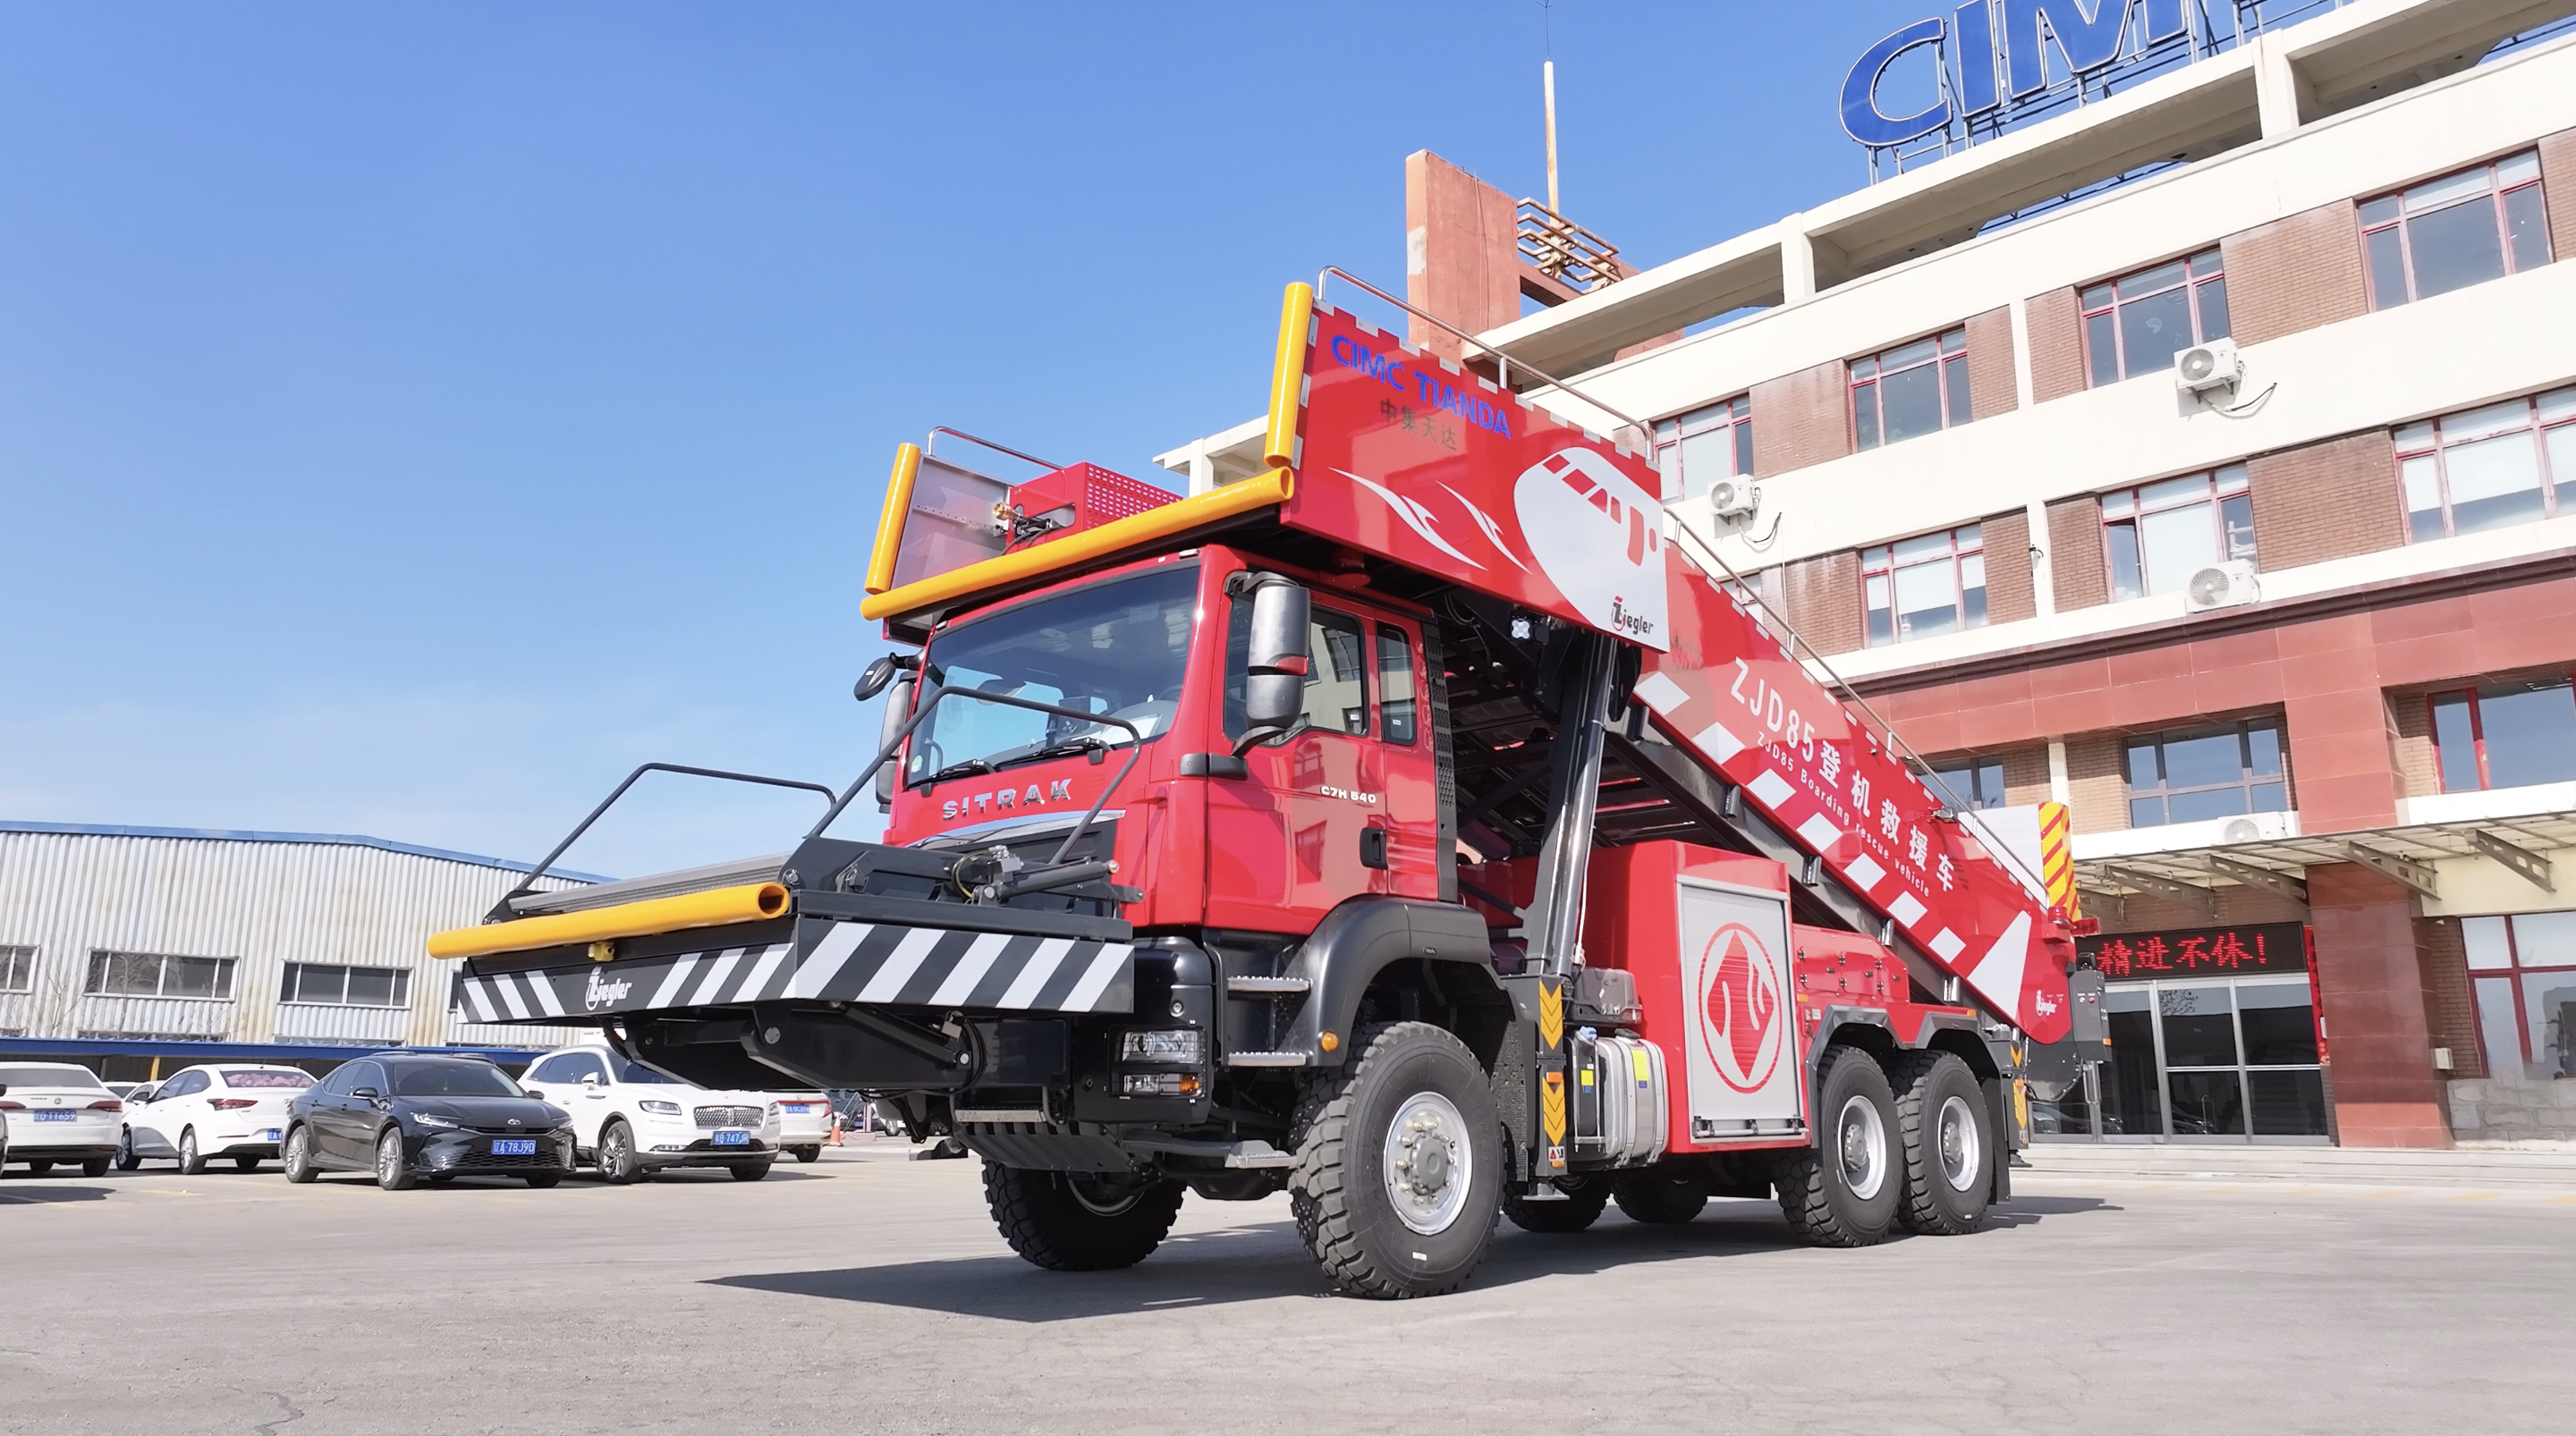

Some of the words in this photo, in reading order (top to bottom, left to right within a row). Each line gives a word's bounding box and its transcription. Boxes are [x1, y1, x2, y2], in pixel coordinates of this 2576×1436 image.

[1331, 334, 1405, 392] CIMC
[1413, 370, 1512, 439] TIANDA
[1380, 398, 1456, 451] 中集天达
[1611, 596, 1654, 635] Ziegler
[1321, 785, 1347, 799] C7H
[1350, 790, 1377, 804] 540
[1731, 656, 1954, 892] ZJD85登机救援车
[943, 778, 1073, 821] SITRAK
[1757, 731, 1793, 772] ZJD85
[1801, 768, 1850, 826] Boarding
[1855, 823, 1889, 859] rescue
[1894, 859, 1929, 897] vehicle
[585, 966, 632, 1011] Ziegler
